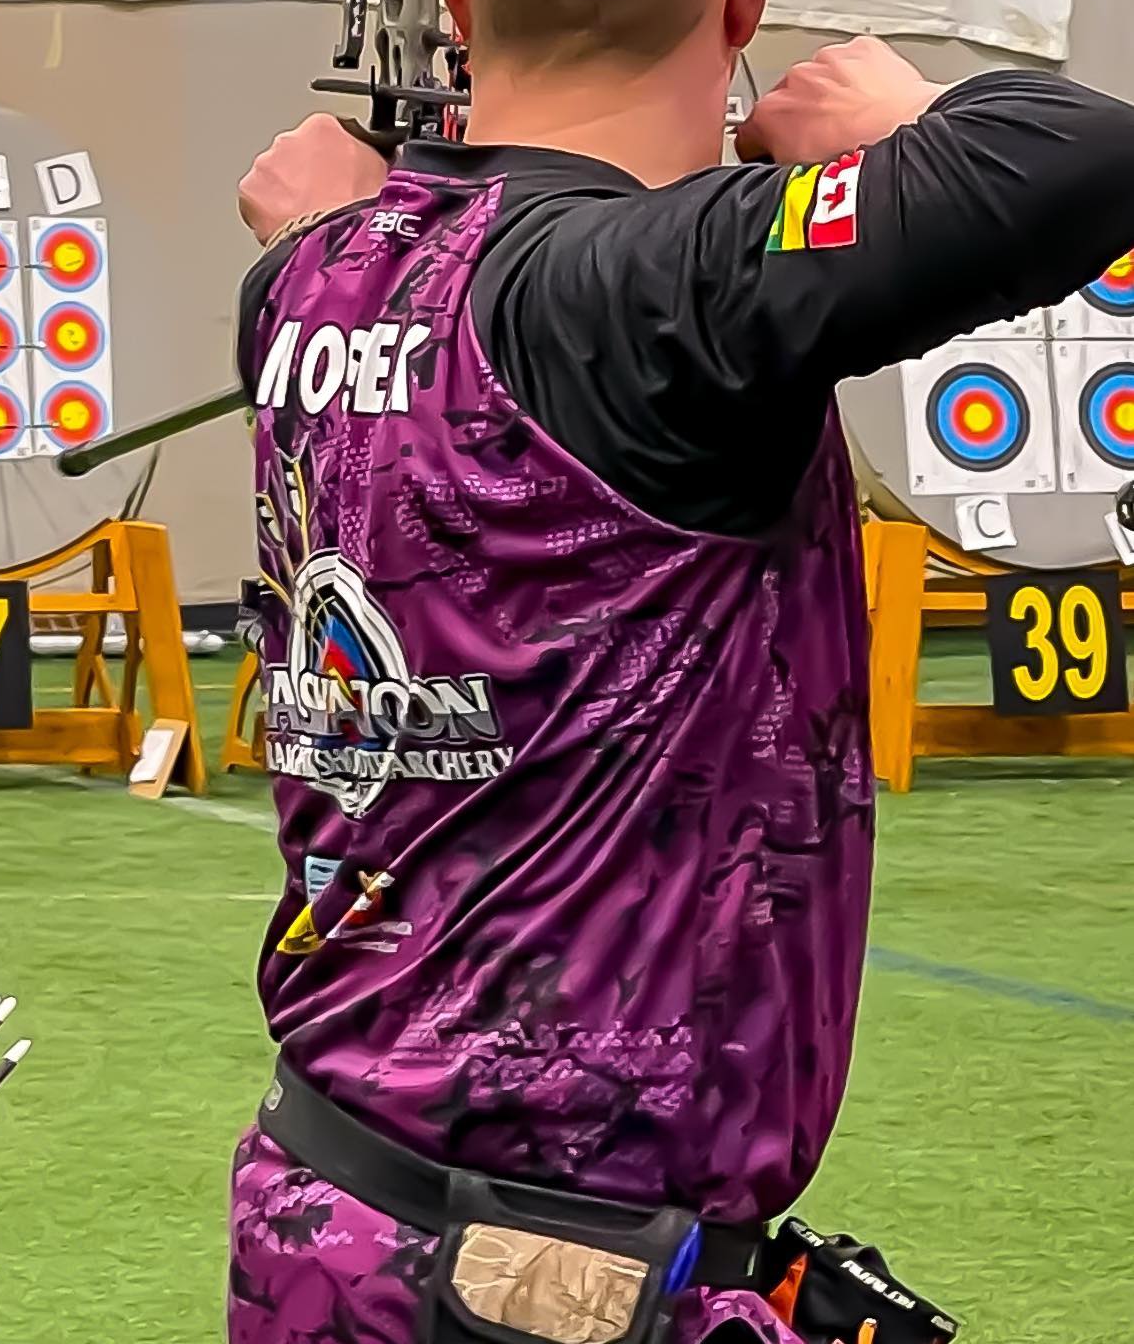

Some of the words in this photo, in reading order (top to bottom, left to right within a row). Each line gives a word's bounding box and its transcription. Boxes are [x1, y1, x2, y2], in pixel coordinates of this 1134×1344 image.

[46, 163, 81, 205] D
[974, 499, 1006, 539] C
[1009, 584, 1108, 701] 39
